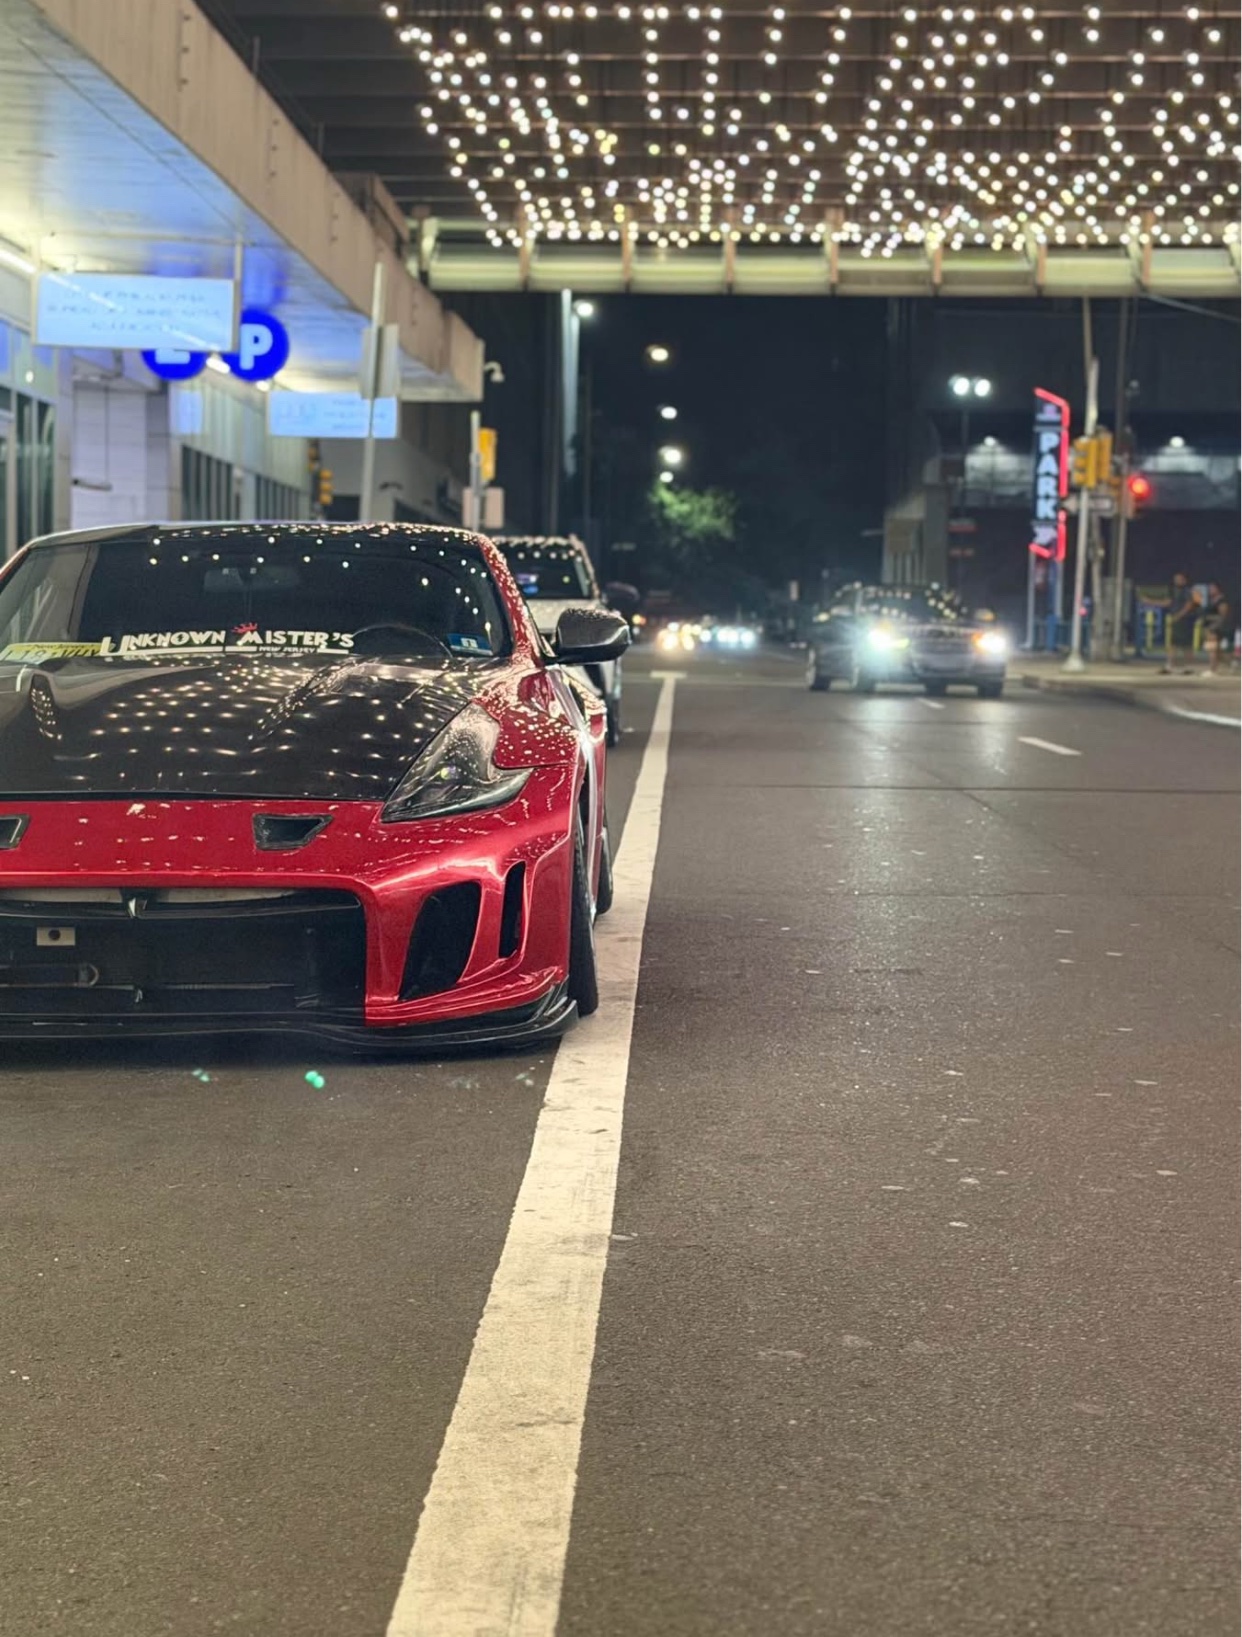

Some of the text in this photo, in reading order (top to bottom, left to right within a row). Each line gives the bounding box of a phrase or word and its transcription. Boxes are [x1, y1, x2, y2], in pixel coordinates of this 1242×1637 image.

[239, 323, 274, 370] P
[1036, 431, 1061, 520] PARK
[100, 630, 355, 655] UNKNOWN MISTER'S
